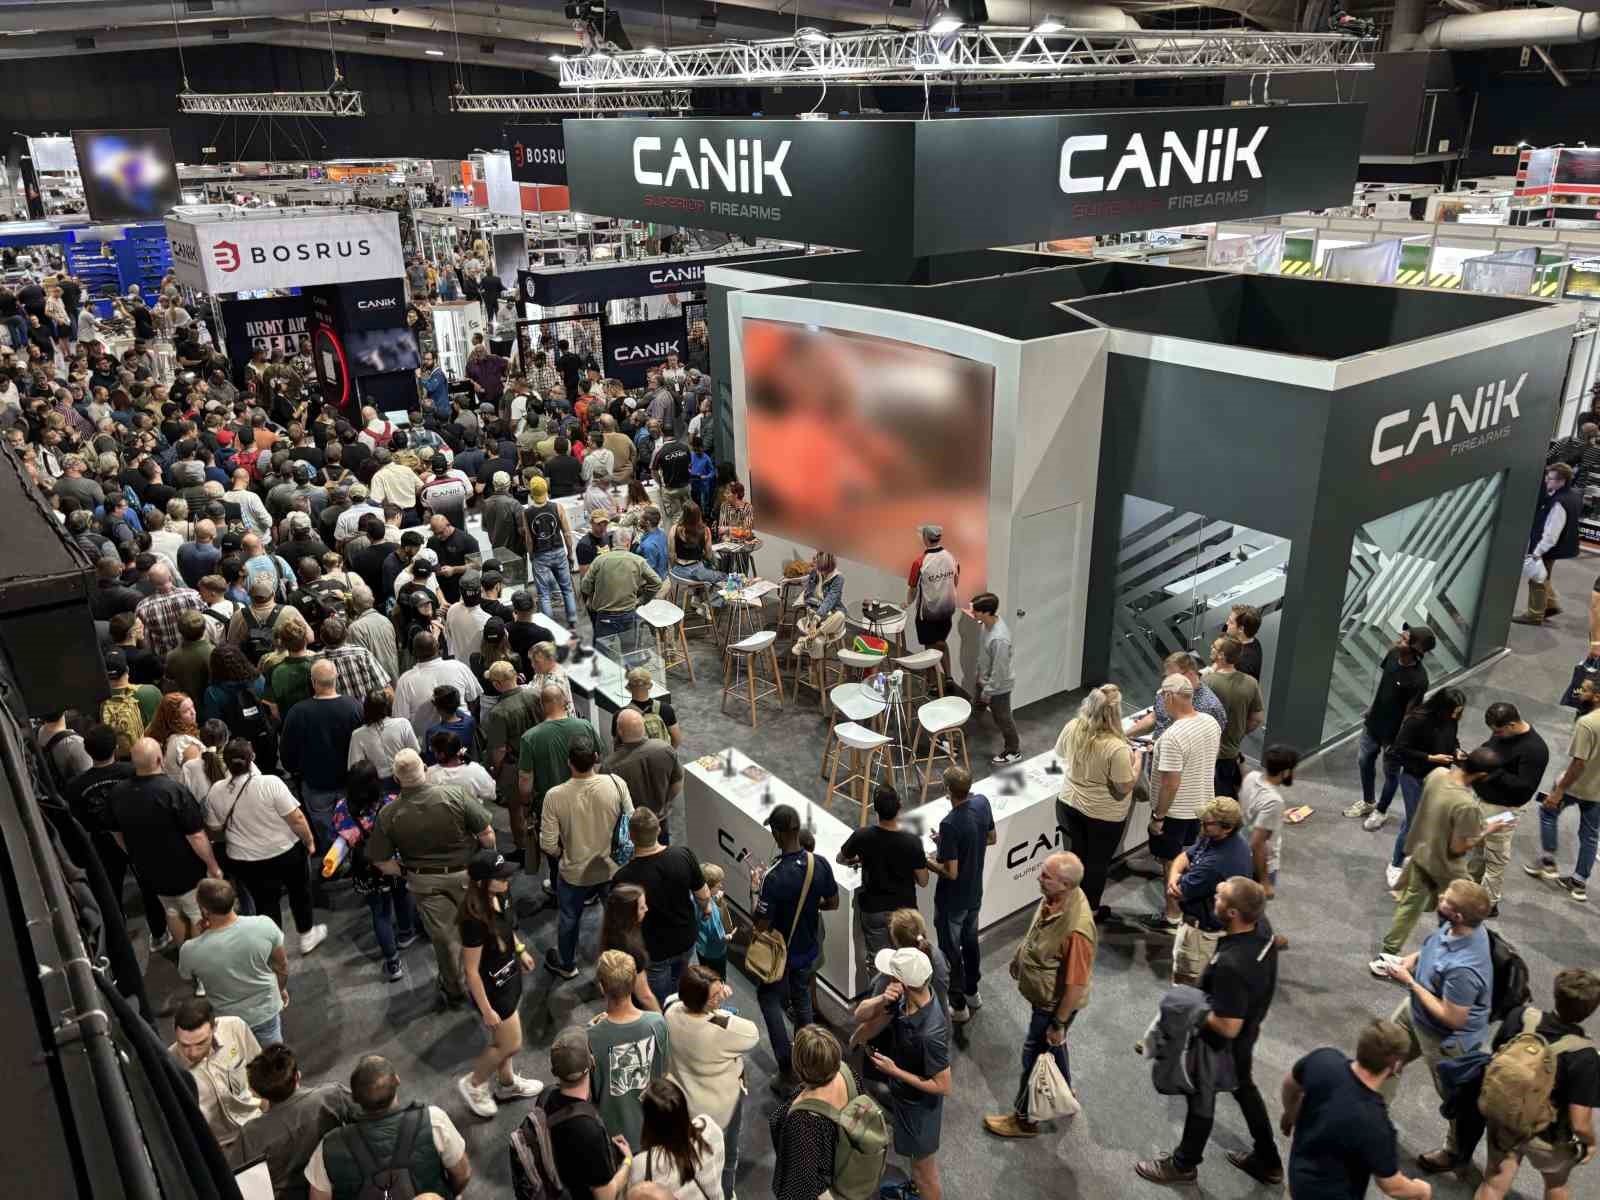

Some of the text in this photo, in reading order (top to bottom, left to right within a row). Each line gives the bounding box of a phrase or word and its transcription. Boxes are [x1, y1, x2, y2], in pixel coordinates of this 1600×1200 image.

[526, 148, 565, 164] BOSRU
[1168, 189, 1249, 210] FIREARMS
[710, 201, 782, 221] FIREARMS
[251, 238, 371, 263] BOSRUS
[245, 319, 284, 337] ARMY
[1450, 425, 1512, 456] FIREARMS
